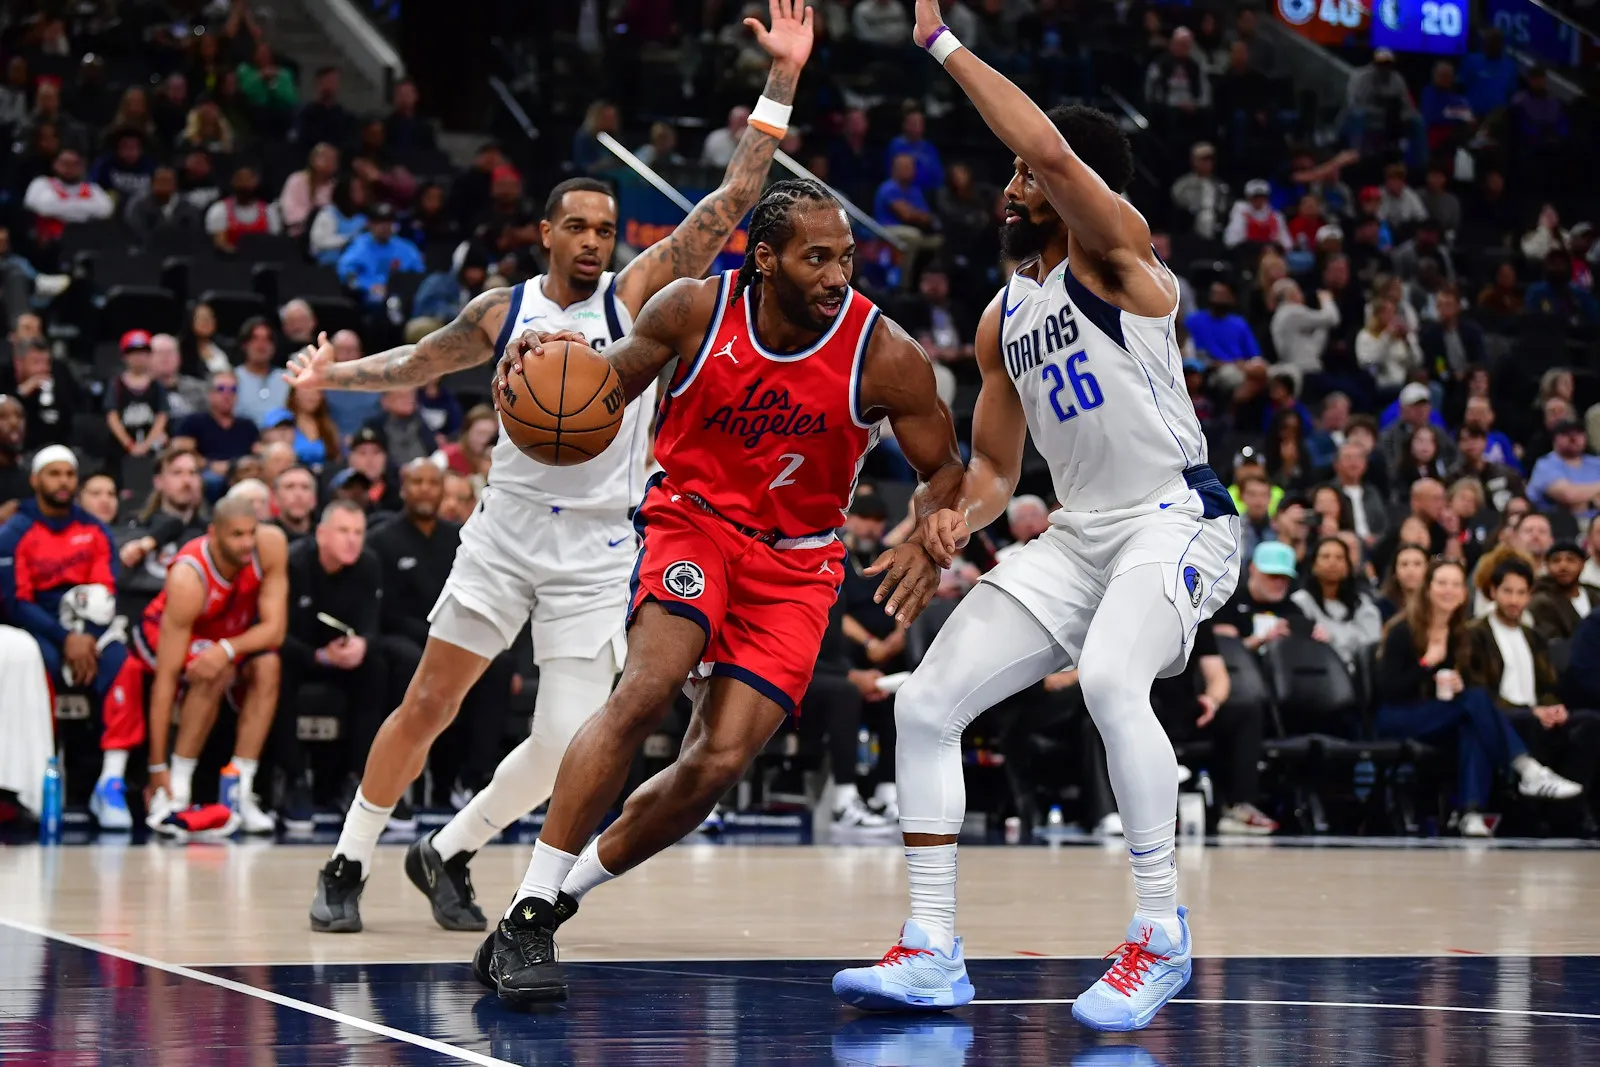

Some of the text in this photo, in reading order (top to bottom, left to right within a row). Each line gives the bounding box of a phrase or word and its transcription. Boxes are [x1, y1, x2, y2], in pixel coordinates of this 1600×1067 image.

[1421, 1, 1461, 36] 20
[737, 377, 792, 412] Los
[1041, 349, 1105, 423] 26
[703, 404, 828, 448] Angeles
[769, 453, 805, 490] 2
